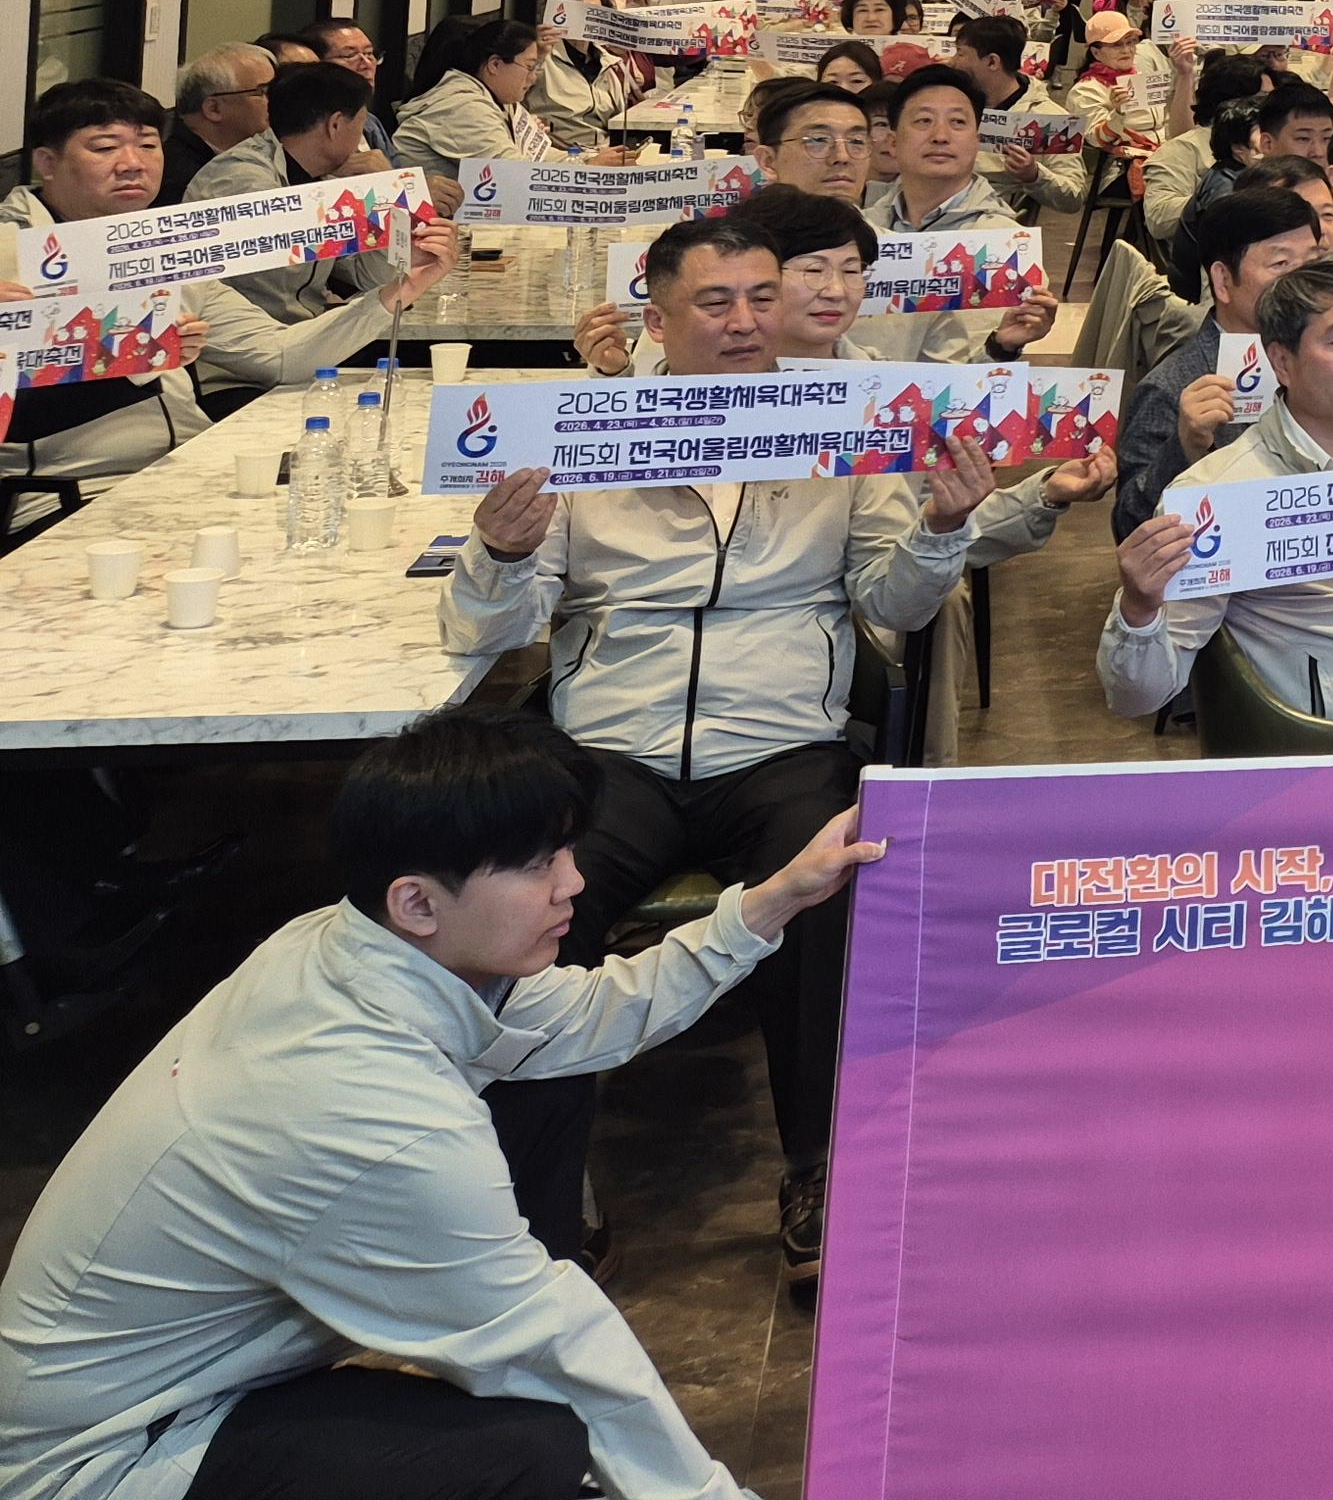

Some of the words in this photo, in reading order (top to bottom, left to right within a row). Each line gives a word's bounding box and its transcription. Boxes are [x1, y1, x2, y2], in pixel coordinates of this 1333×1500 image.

[530, 168, 571, 184] 2026
[574, 166, 699, 187] 전국생활체육대축전
[528, 197, 567, 213] 제5회
[571, 191, 740, 215] 전국어울림생활체육대축전
[107, 219, 153, 242] 2026
[157, 194, 303, 234] 전국생활체육대축전
[109, 257, 156, 280] 제5회
[160, 221, 356, 272] 전국어울림생활체육대축전
[557, 390, 628, 415] 2026
[634, 381, 849, 415] 전국생활체육대축전
[560, 419, 591, 433] 2026.
[552, 440, 621, 469] 제5회
[627, 428, 912, 466] 전국어울림생활체육대축전
[554, 472, 588, 485] 2026.
[1265, 484, 1321, 512] 2026
[1265, 535, 1320, 563] 제5회
[1208, 568, 1231, 584] 김해
[1031, 848, 1217, 909] 대전환의
[998, 905, 1140, 964] 글로컬
[1150, 899, 1248, 956] 시티
